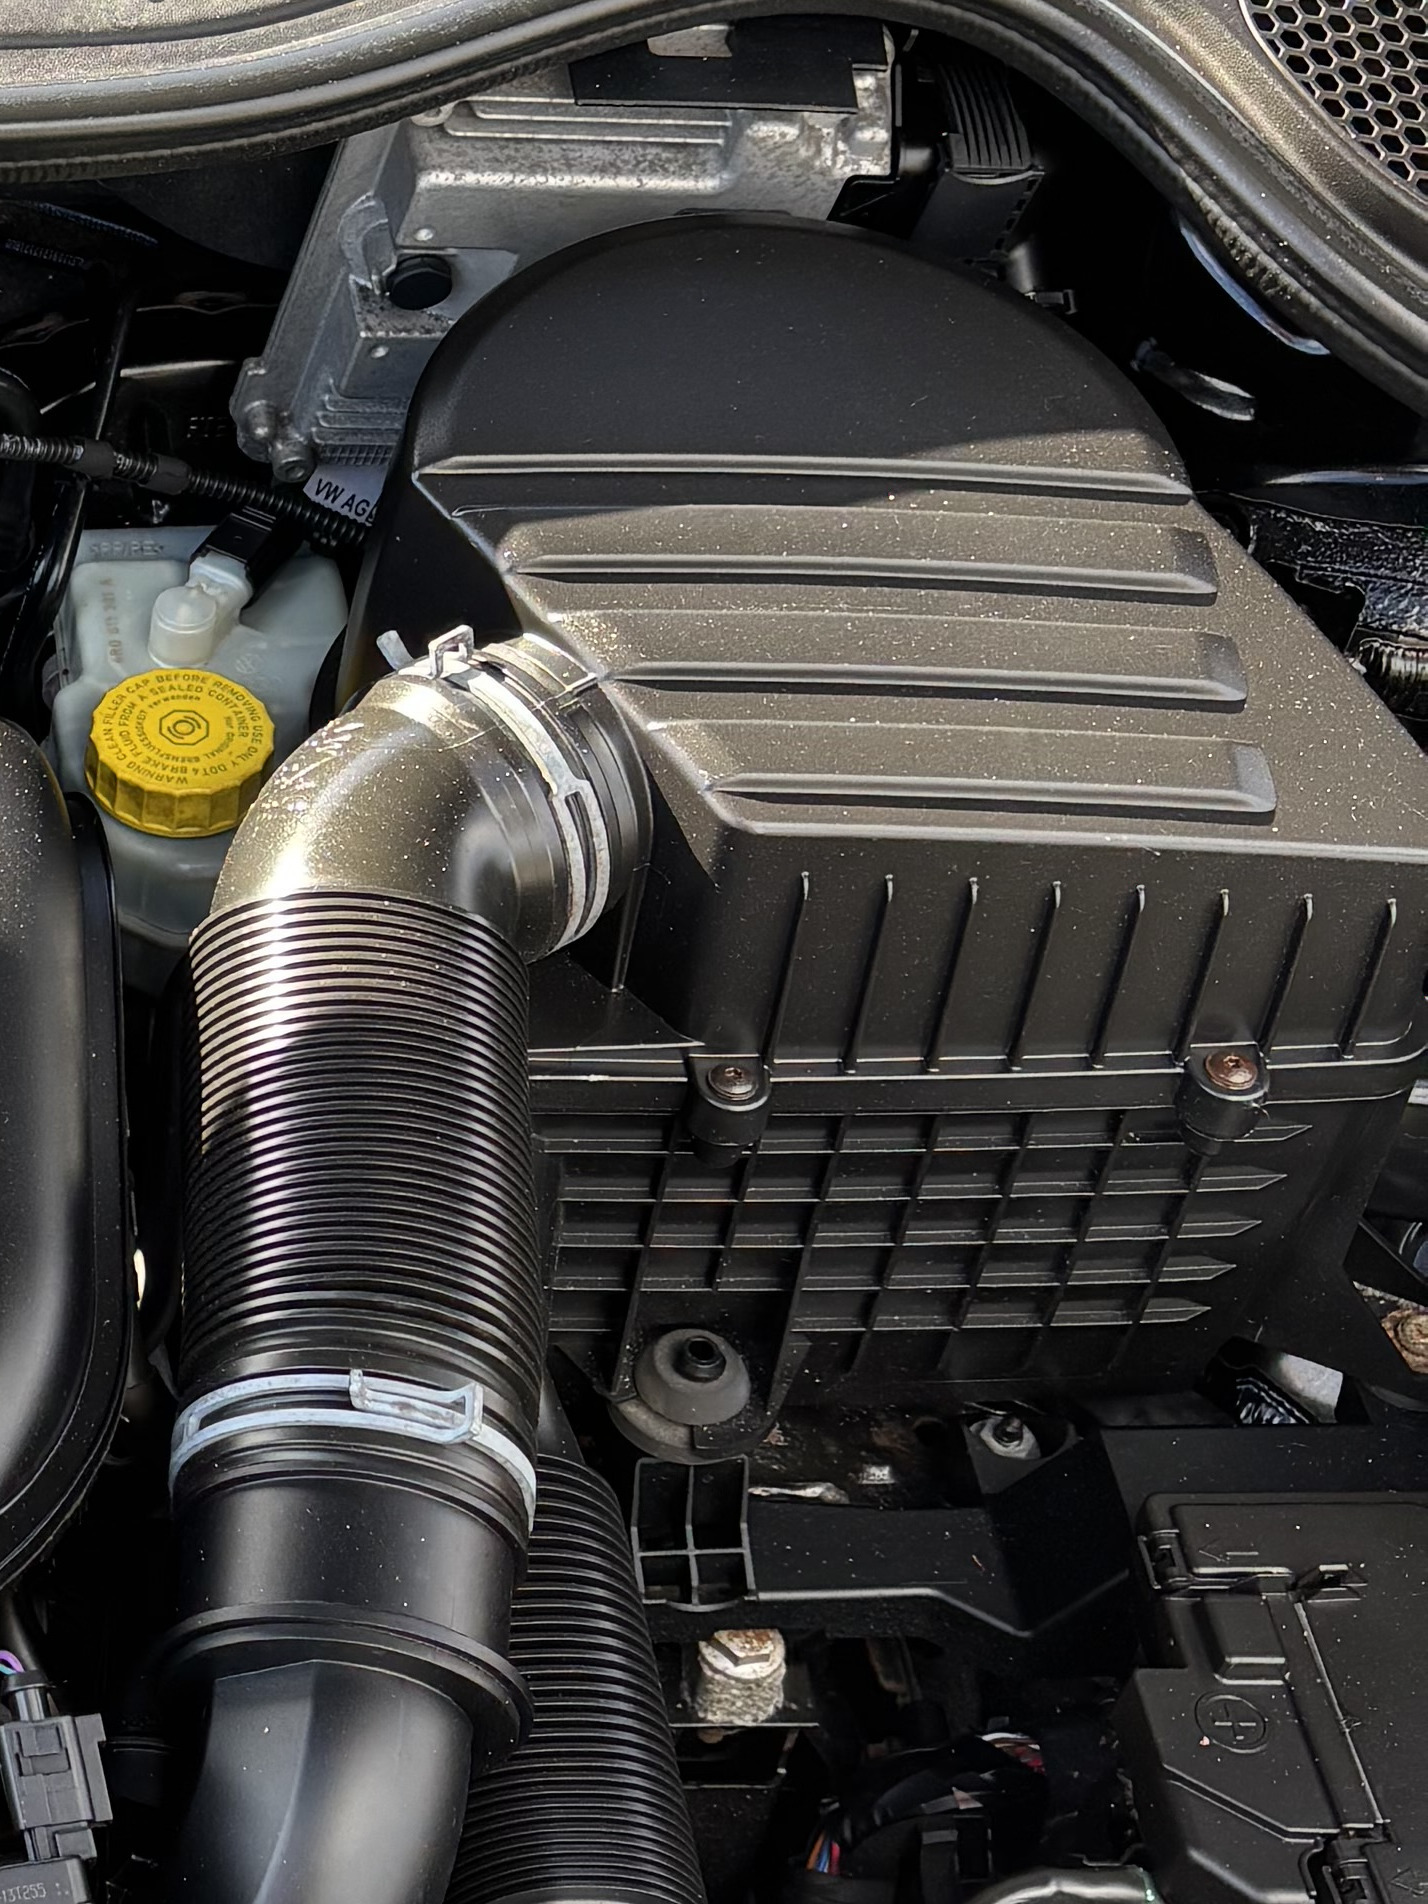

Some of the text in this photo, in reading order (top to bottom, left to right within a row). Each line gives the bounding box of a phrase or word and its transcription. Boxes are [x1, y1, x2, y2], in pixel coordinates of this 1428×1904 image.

[315, 478, 345, 505] VW
[125, 677, 151, 695] CAP
[149, 683, 204, 696] SEALED
[156, 673, 208, 684] BEFORE
[102, 694, 127, 727] FILLER
[211, 679, 261, 723] REMOVING
[118, 702, 137, 728] FROM
[207, 688, 250, 739] CONTAINER
[102, 727, 127, 762] CLEAN
[252, 724, 263, 746] USE
[144, 755, 188, 775] BRAKE
[230, 745, 259, 768] ONLY
[126, 761, 188, 785] WARNING
[201, 763, 229, 778] DOT
